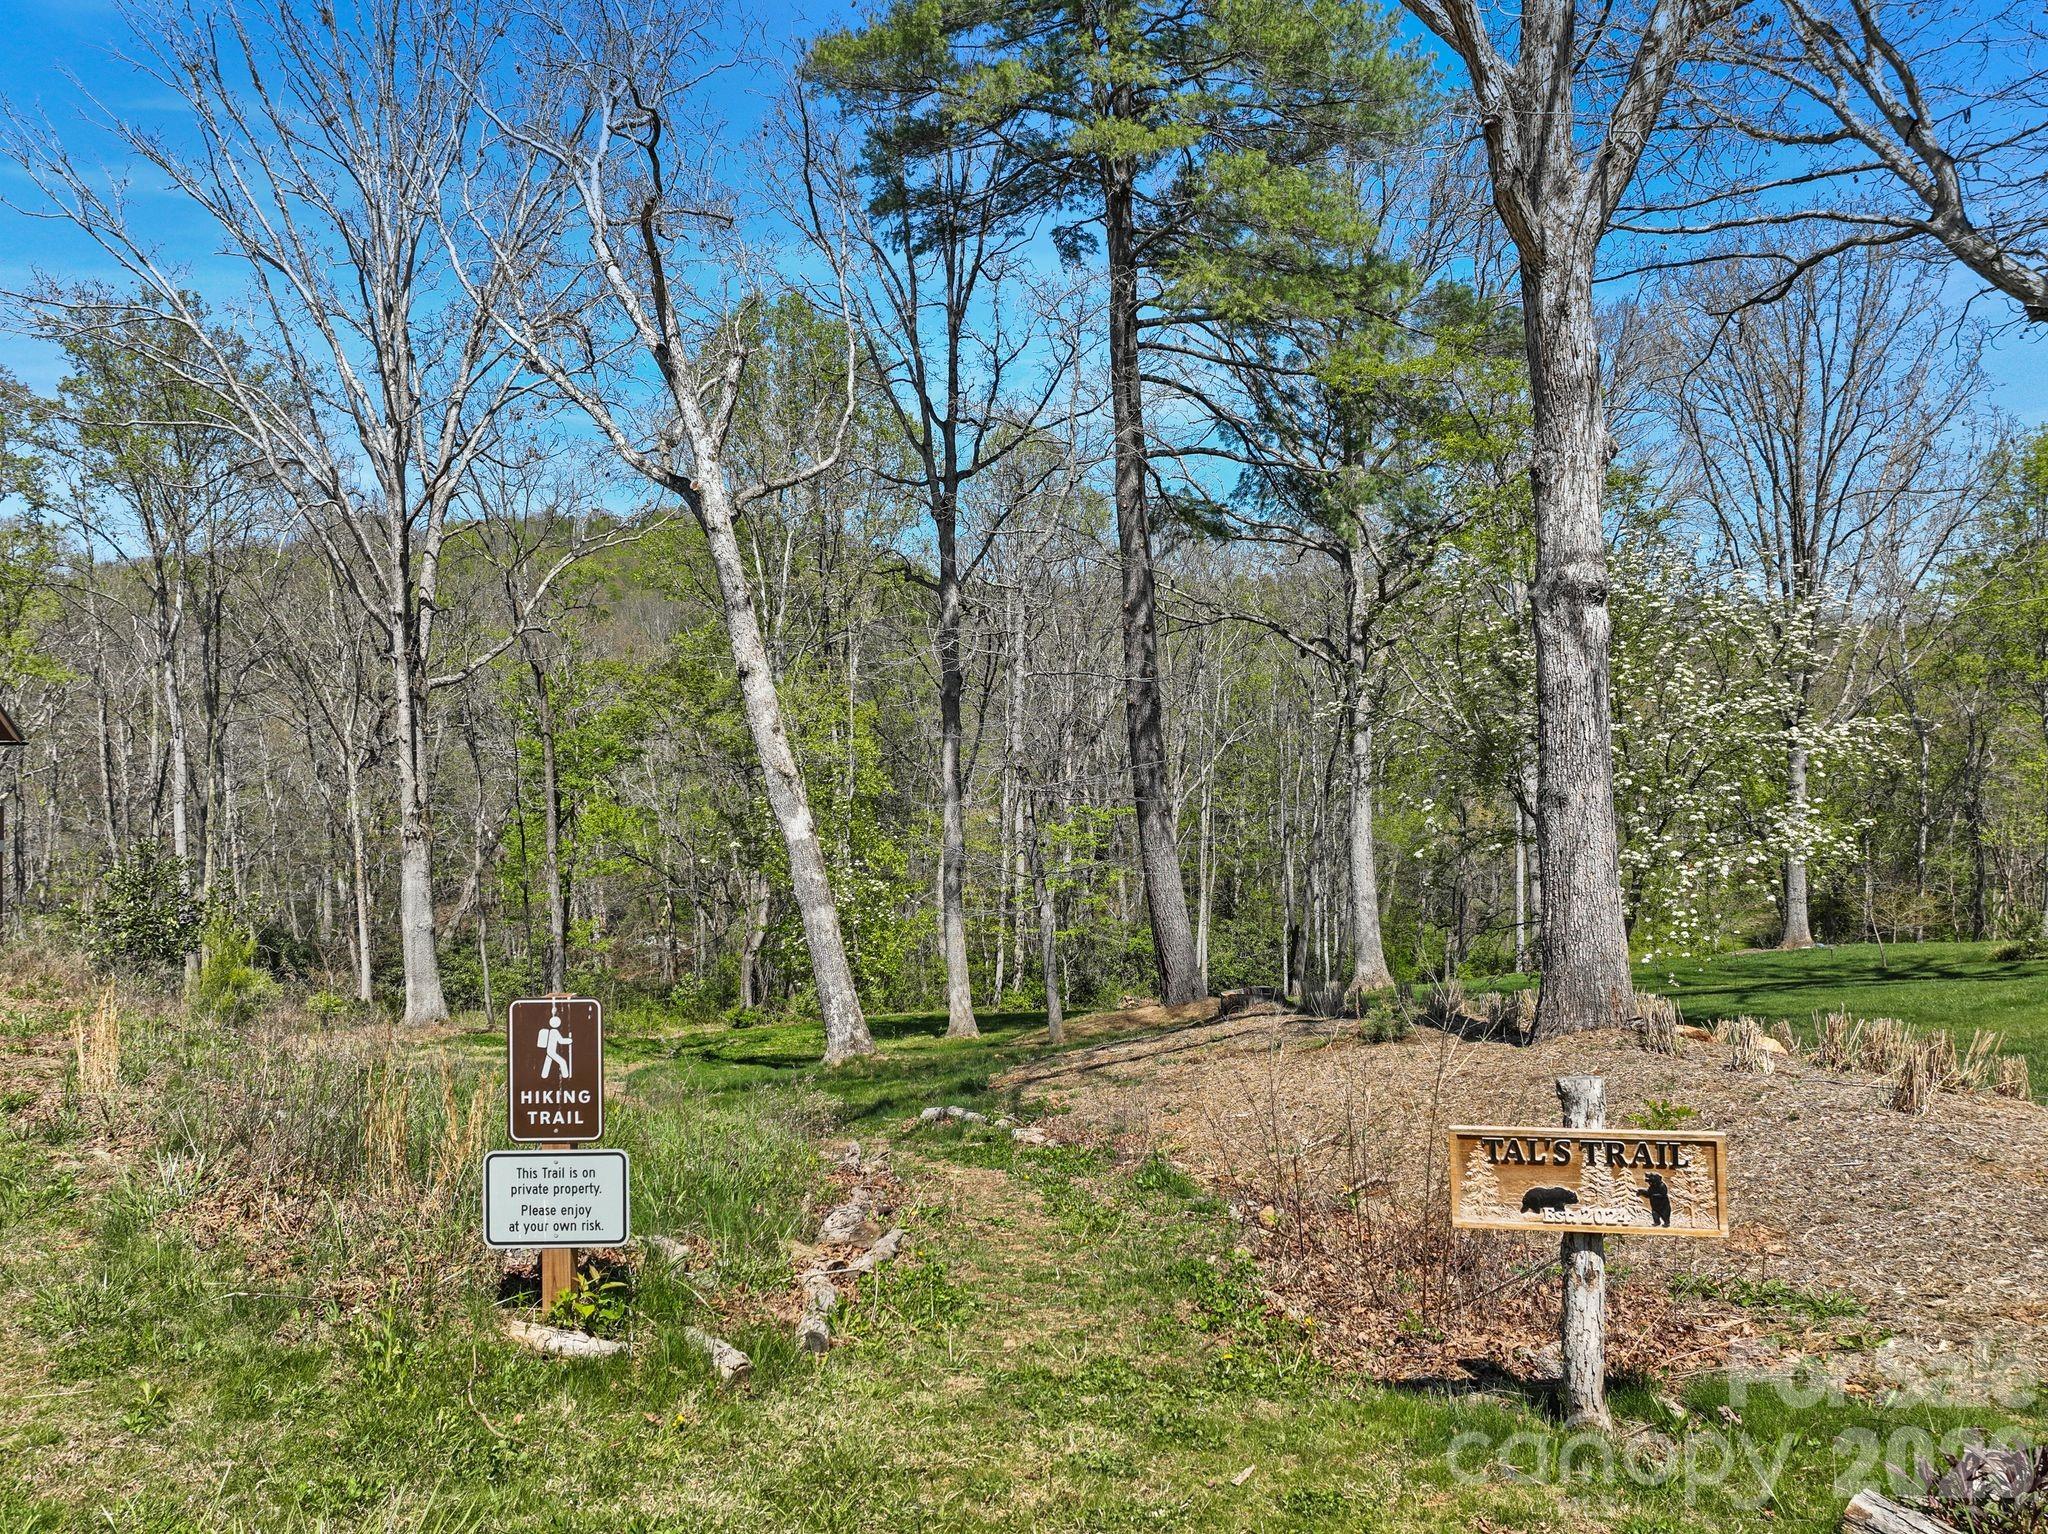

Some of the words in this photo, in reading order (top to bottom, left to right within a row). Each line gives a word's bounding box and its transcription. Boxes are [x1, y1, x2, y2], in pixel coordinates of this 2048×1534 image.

[520, 1090, 591, 1104] HIKING
[527, 1110, 585, 1125] TRAIL
[1481, 1137, 1573, 1166] TAL'S
[1579, 1140, 1690, 1169] TRAIL
[516, 1167, 538, 1179] This
[542, 1167, 565, 1179] Trail
[569, 1167, 578, 1179] is
[582, 1169, 596, 1179] on
[510, 1184, 549, 1198] private
[553, 1183, 602, 1197] property.
[521, 1204, 557, 1217] Please
[560, 1205, 592, 1219] enjoy
[509, 1221, 520, 1232] at
[524, 1222, 549, 1235] your
[552, 1222, 577, 1232] own
[581, 1220, 604, 1232] risk.
